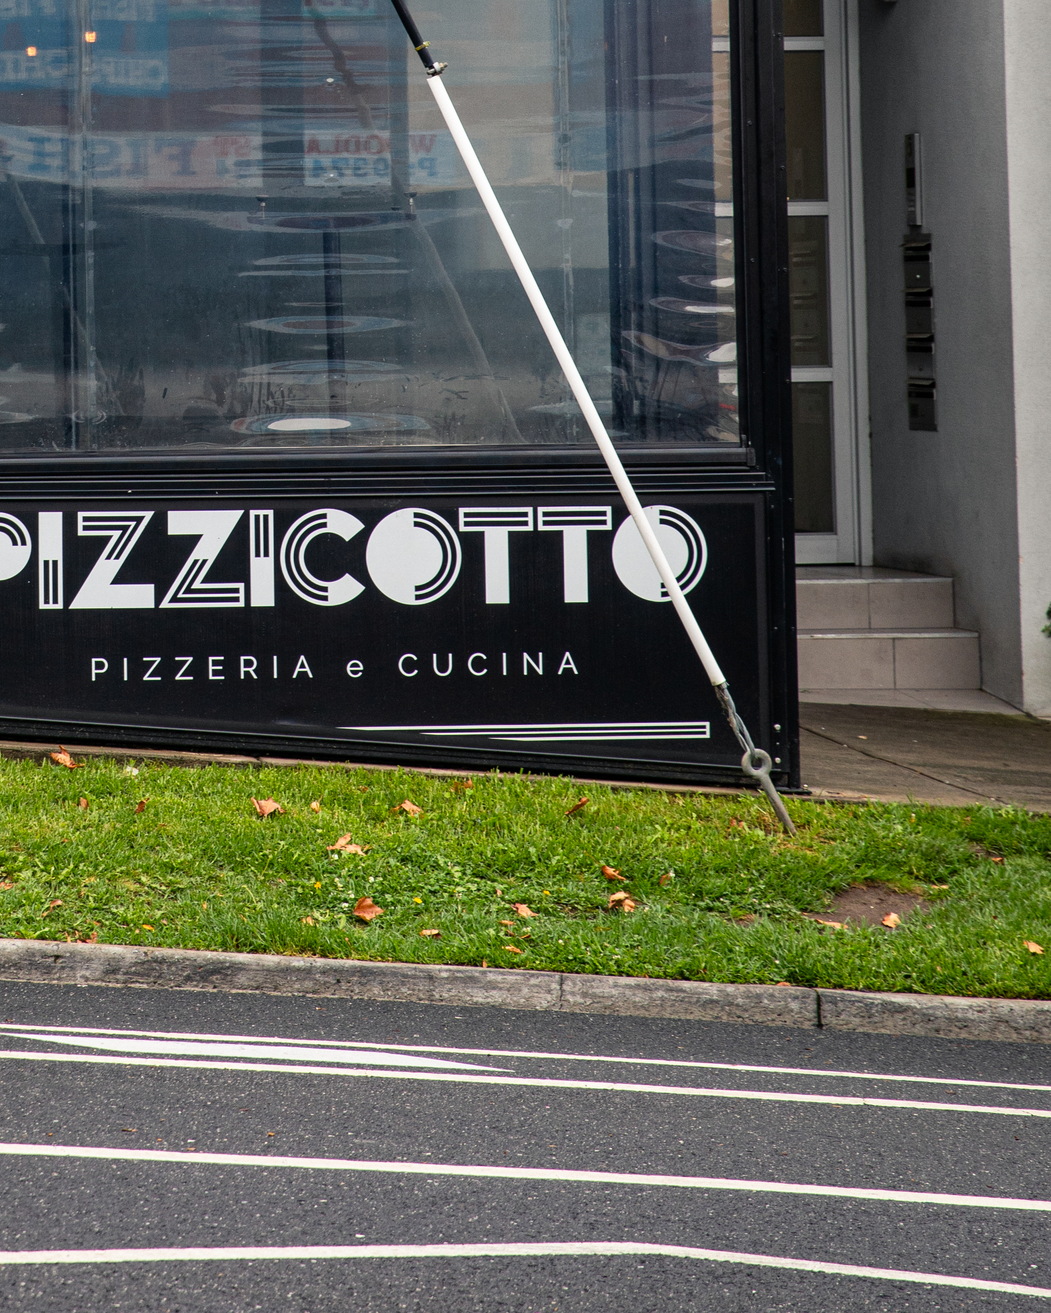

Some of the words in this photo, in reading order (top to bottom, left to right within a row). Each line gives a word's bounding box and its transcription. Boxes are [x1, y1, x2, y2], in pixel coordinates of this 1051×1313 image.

[91, 655, 314, 682] PIZZERIA
[346, 660, 364, 678] e
[397, 651, 580, 678] CUCINA
